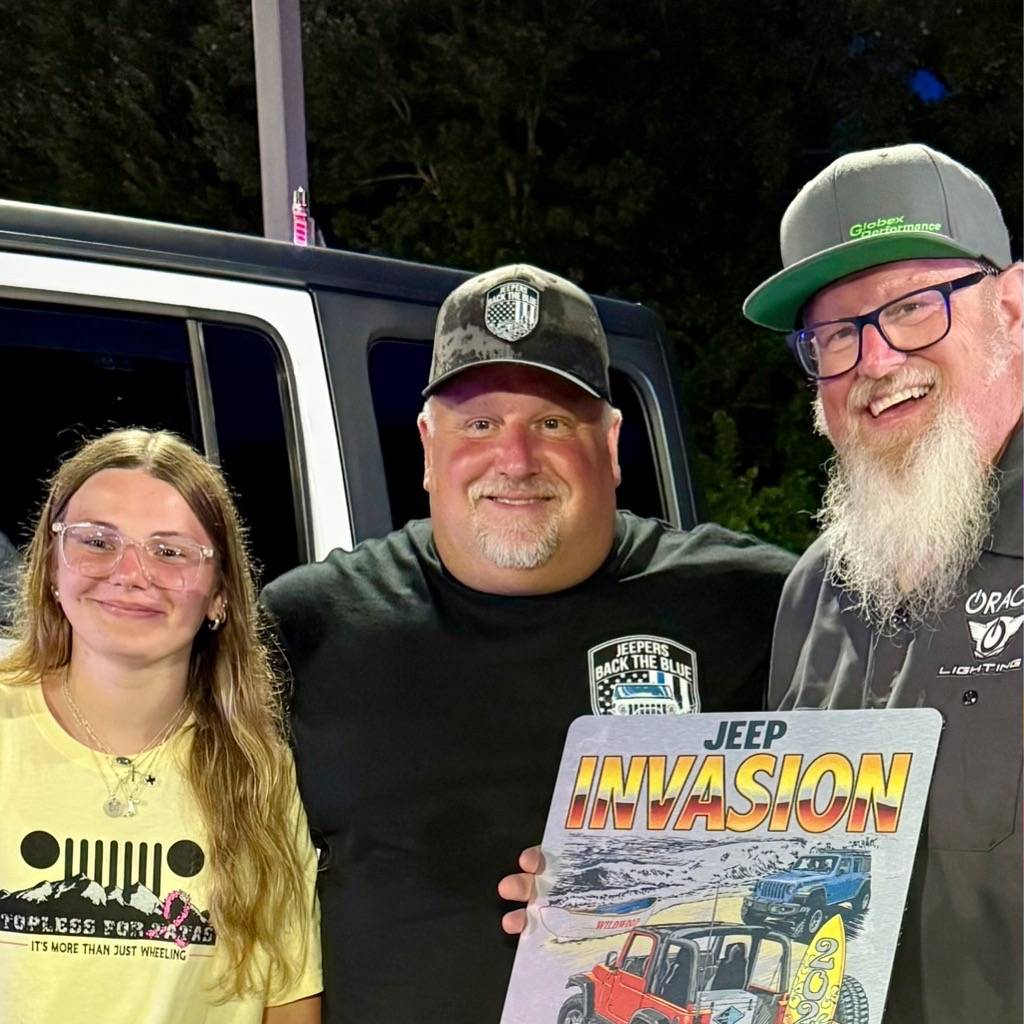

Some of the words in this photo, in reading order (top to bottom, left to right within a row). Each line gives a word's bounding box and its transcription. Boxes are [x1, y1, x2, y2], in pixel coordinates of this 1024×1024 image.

[849, 215, 904, 237] Globex
[861, 223, 941, 238] Performance
[616, 641, 670, 658] JEEPERS
[595, 657, 630, 681] BACK
[631, 654, 657, 669] THE
[660, 657, 693, 683] BLUE
[938, 658, 1022, 675] LIGHTING
[704, 720, 787, 750] JEEP
[565, 752, 913, 833] INVASION
[1, 914, 96, 935] TOPLESS
[104, 920, 144, 937] FOR
[31, 941, 48, 952] IT'S
[51, 942, 79, 954] MORE
[83, 944, 110, 956] THAN
[114, 947, 136, 957] JUST
[140, 948, 187, 961] WHEELING
